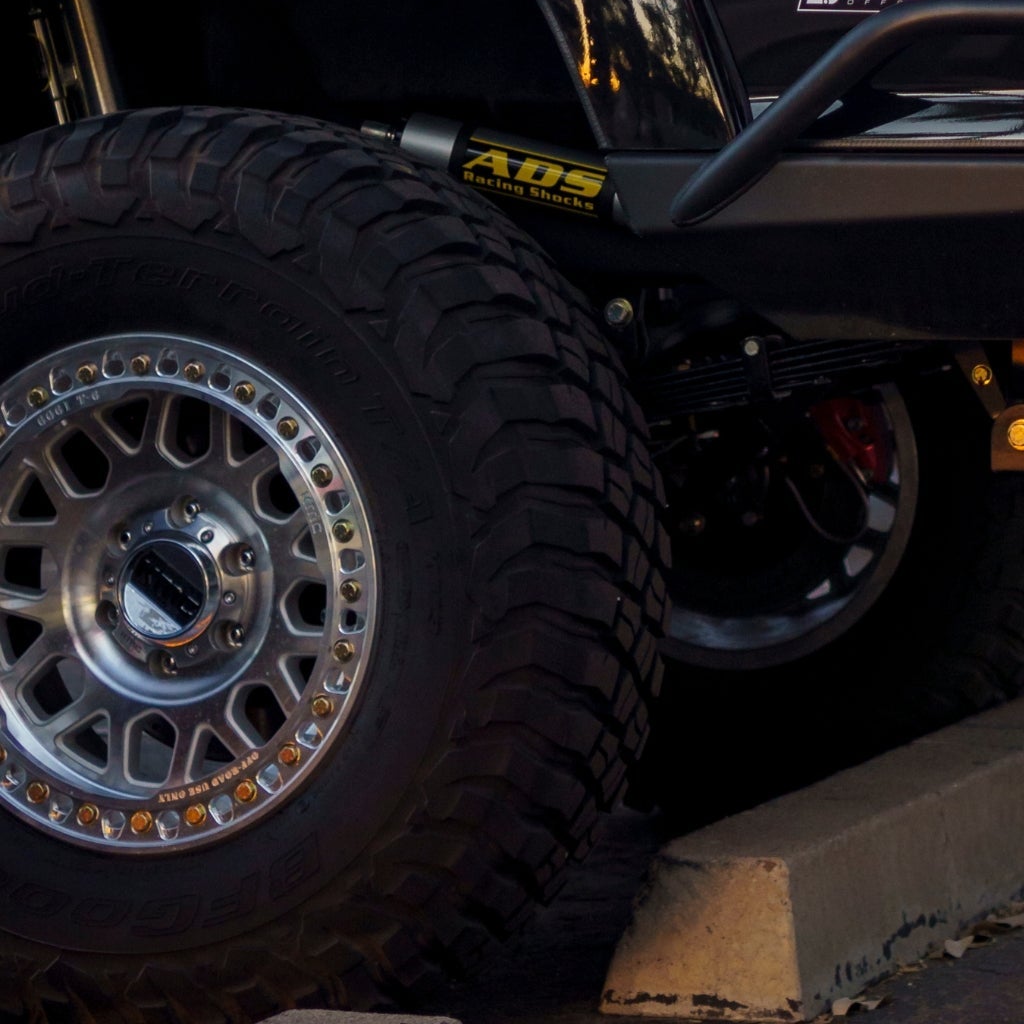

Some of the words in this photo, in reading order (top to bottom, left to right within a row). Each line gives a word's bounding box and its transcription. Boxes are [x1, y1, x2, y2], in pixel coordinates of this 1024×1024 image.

[462, 149, 606, 198] ADS
[463, 171, 525, 196] Racing
[529, 187, 595, 211] Shocks
[211, 751, 259, 787] OFF-ROAD
[158, 790, 187, 803] ONLY
[188, 781, 210, 796] USE
